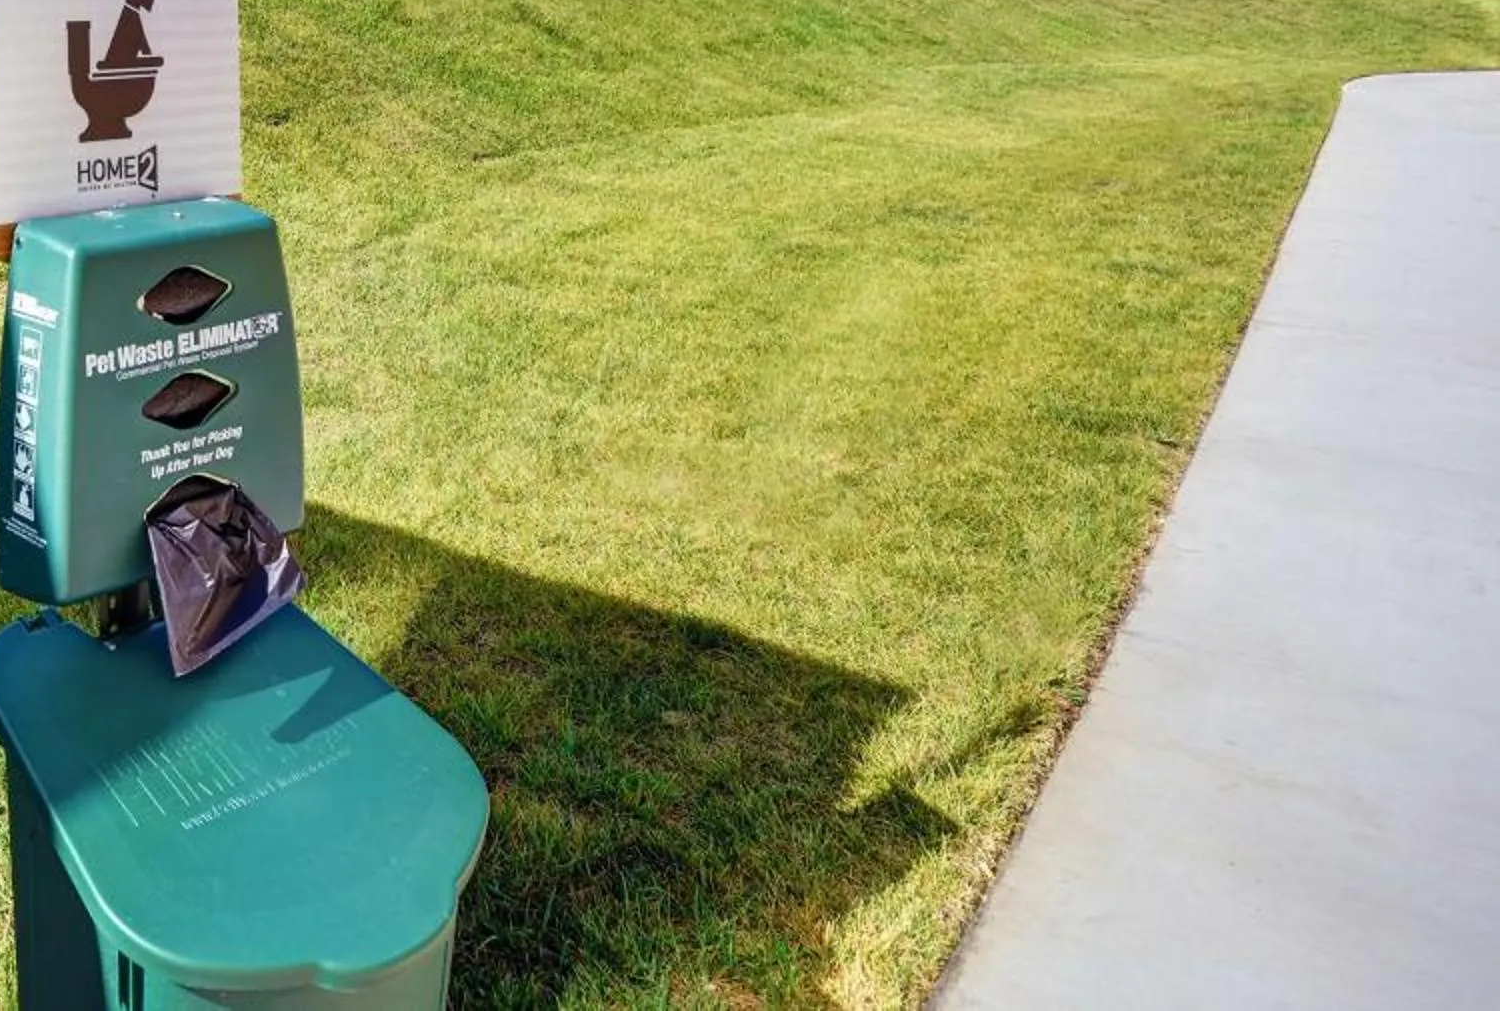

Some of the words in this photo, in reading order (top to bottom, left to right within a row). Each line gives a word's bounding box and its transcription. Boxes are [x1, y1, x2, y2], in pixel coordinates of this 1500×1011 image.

[85, 350, 116, 377] Pet
[117, 339, 175, 369] Waste
[141, 445, 171, 464] Thank
[173, 441, 191, 454] You
[192, 436, 206, 449] for
[207, 426, 243, 444] Picking
[151, 465, 165, 481] Up
[166, 458, 191, 474] After
[193, 451, 214, 466] Your
[216, 446, 235, 460] Dog
